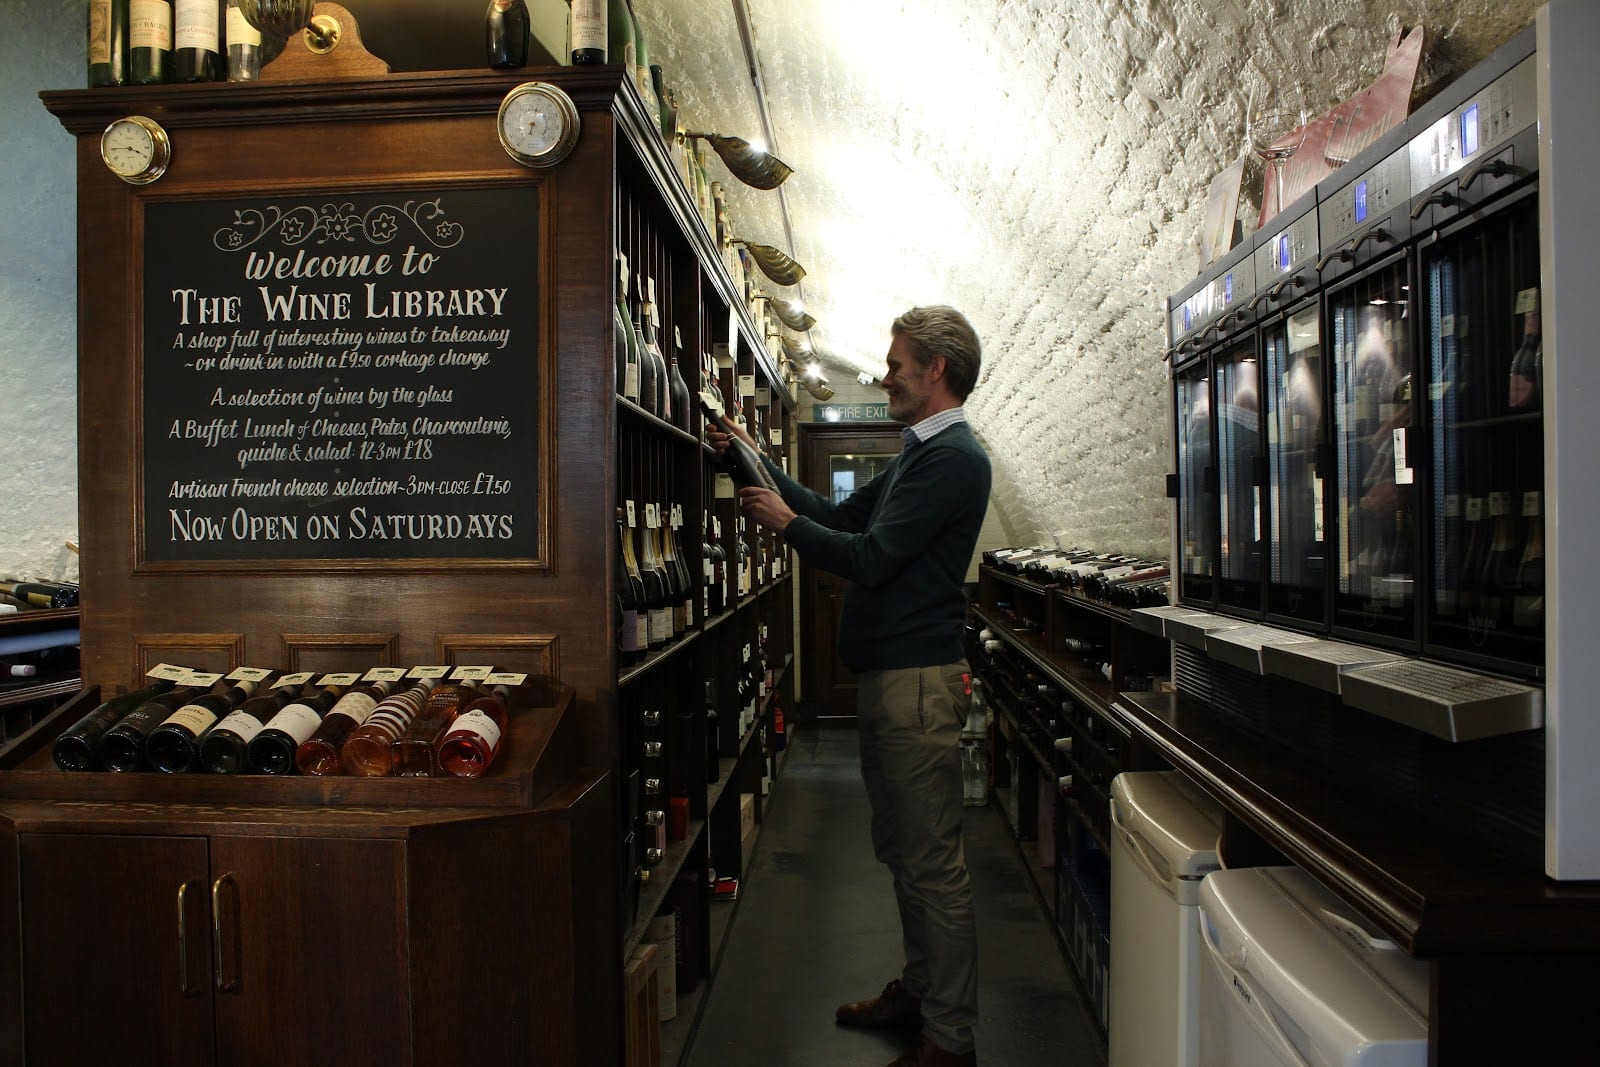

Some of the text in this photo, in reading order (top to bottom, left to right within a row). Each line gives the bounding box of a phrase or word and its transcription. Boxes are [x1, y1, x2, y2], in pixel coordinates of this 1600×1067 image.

[245, 245, 440, 280] Welcome to
[172, 283, 508, 325] THE WINE LIBRARY
[173, 325, 511, 355] A shop full of interesting wines to takeaway
[287, 351, 324, 369] with
[326, 356, 337, 369] a
[338, 350, 371, 368] £9.50
[375, 350, 435, 374] corkage
[438, 349, 491, 371] charge
[211, 385, 454, 413] A selection of wines by the glass
[839, 407, 861, 419] FIRE
[866, 407, 888, 418] EXIT
[168, 419, 181, 439] A
[185, 418, 239, 448] Buffet
[244, 418, 295, 438] Lunch
[297, 420, 310, 440] of
[312, 418, 369, 439] Cheeses,
[237, 441, 289, 469] quiche
[289, 443, 302, 461] &
[403, 438, 433, 460] £18
[168, 479, 228, 499] Artisan
[231, 478, 281, 497] French
[283, 477, 329, 497] cheese
[472, 472, 512, 495] £7.50
[169, 506, 514, 542] NOW OPEN ON SATURDAYS
